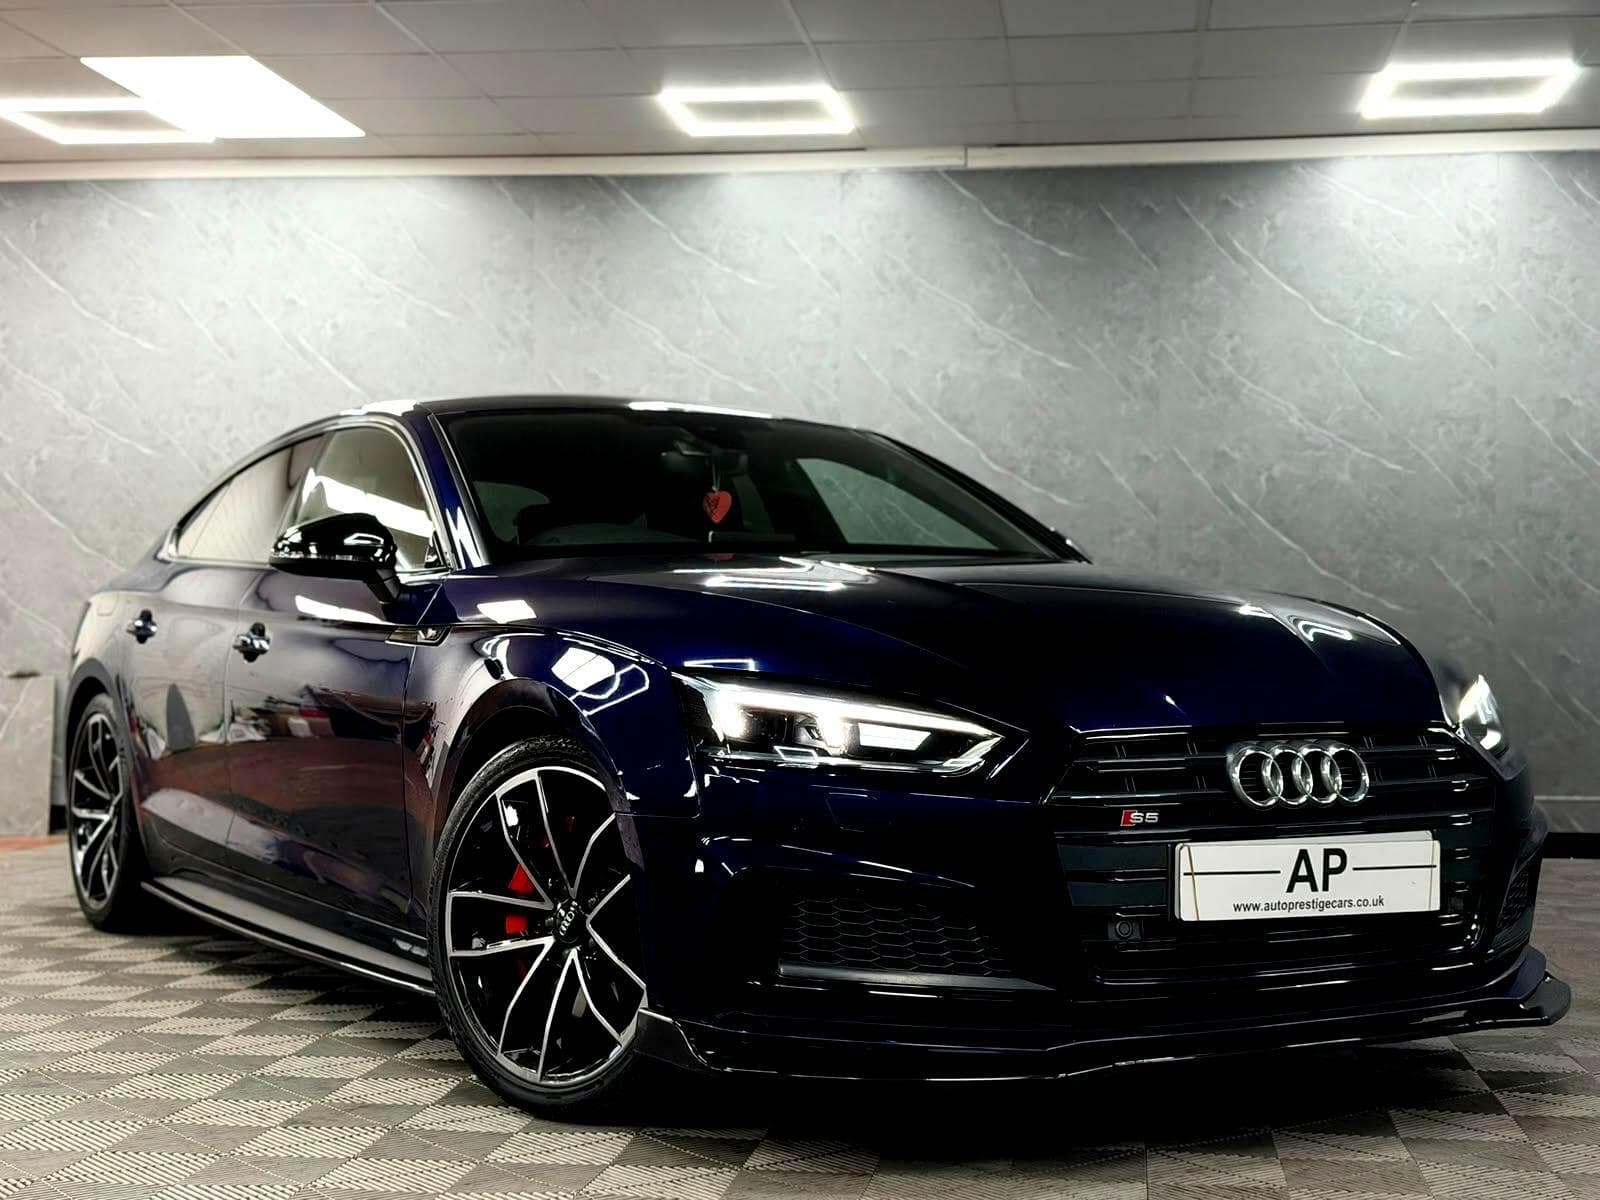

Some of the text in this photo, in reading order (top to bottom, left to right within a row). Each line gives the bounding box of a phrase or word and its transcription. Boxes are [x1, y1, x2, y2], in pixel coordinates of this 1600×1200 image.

[1129, 812, 1159, 823] S5
[1286, 848, 1347, 893] AP
[1233, 895, 1384, 912] www.autoprestigecars.co.uk
